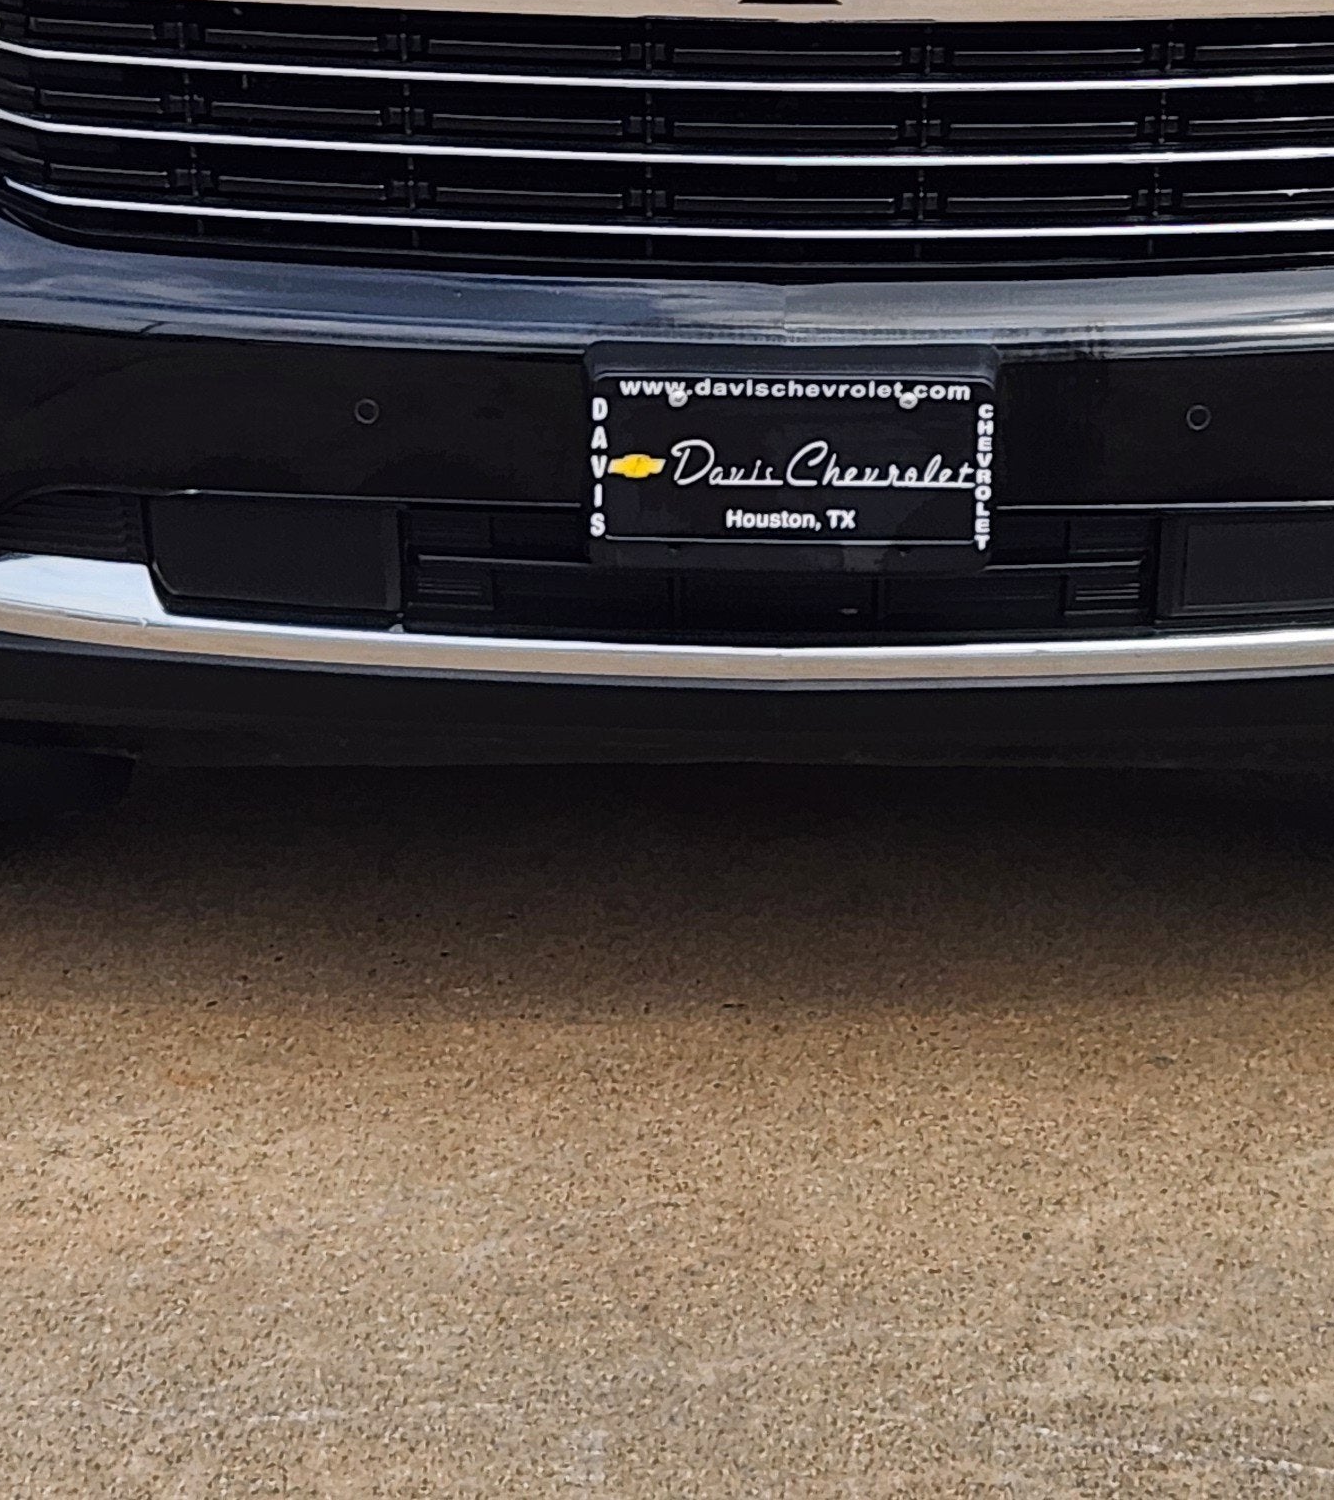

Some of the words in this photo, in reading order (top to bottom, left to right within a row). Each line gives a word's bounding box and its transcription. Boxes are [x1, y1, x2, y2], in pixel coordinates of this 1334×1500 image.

[619, 379, 971, 401] www.davischevroletcom
[590, 396, 609, 537] DAVIS
[671, 439, 784, 486] Davis
[785, 440, 976, 488] Chevrolet
[974, 402, 994, 551] CHEVROLET
[725, 509, 822, 531] Houston,
[826, 509, 857, 529] TX
